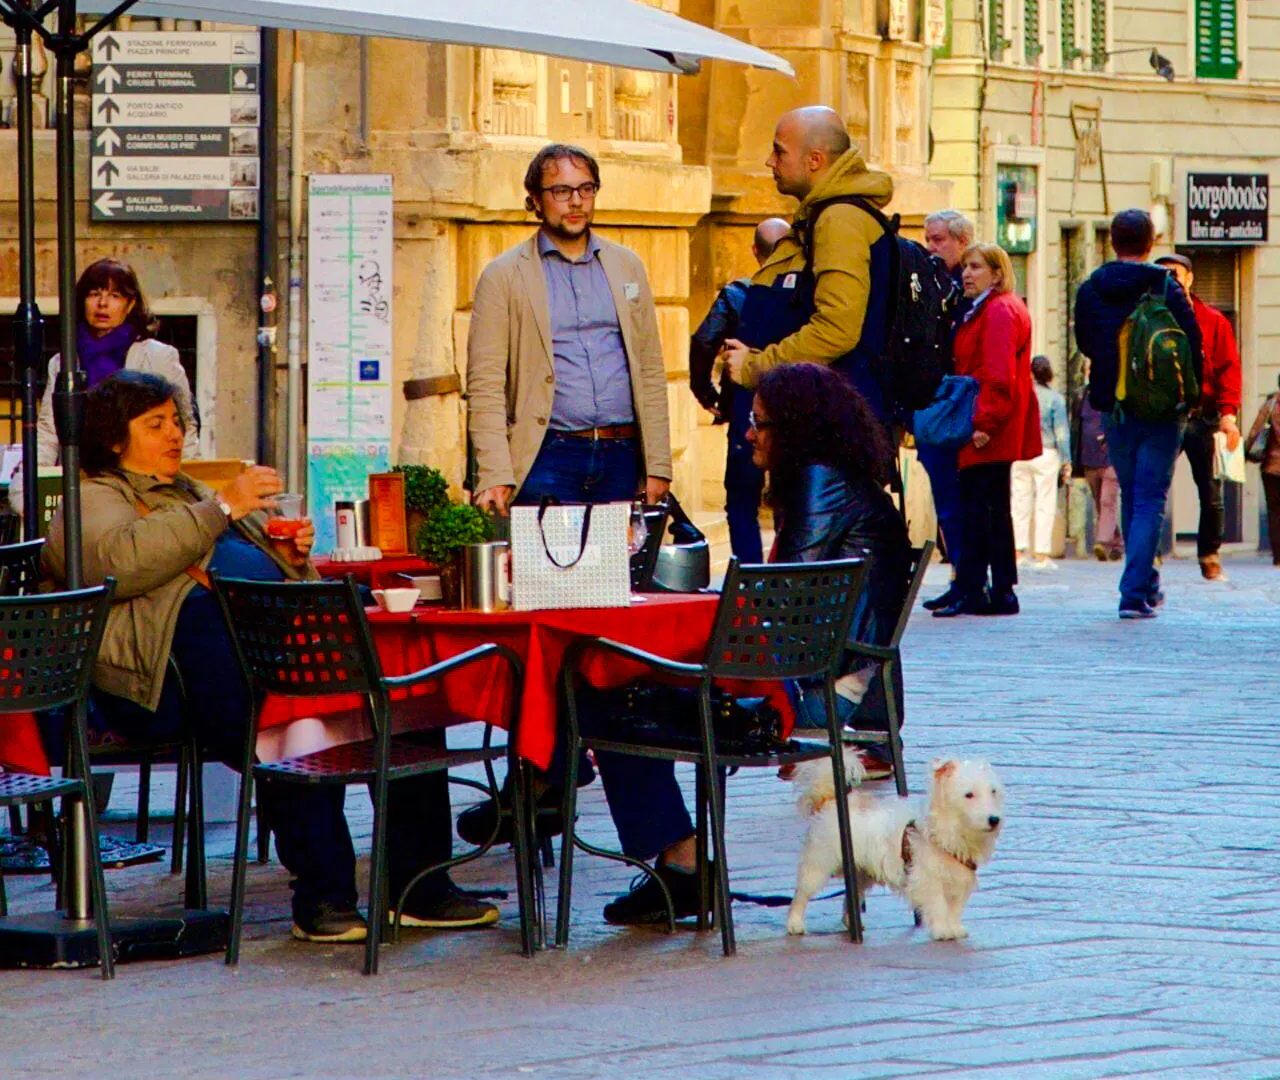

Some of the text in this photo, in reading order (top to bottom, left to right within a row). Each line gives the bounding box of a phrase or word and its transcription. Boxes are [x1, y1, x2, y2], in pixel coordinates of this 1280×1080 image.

[126, 70, 195, 78] FERRY TERMINAL
[126, 79, 197, 87] CRUISE TERMINAL
[126, 133, 222, 141] GALATA MUSEO DEL MARE
[126, 196, 163, 204] GALLERIA
[1189, 175, 1267, 220] borgobooks
[135, 204, 169, 212] PALAZZO
[1191, 219, 1209, 238] libri
